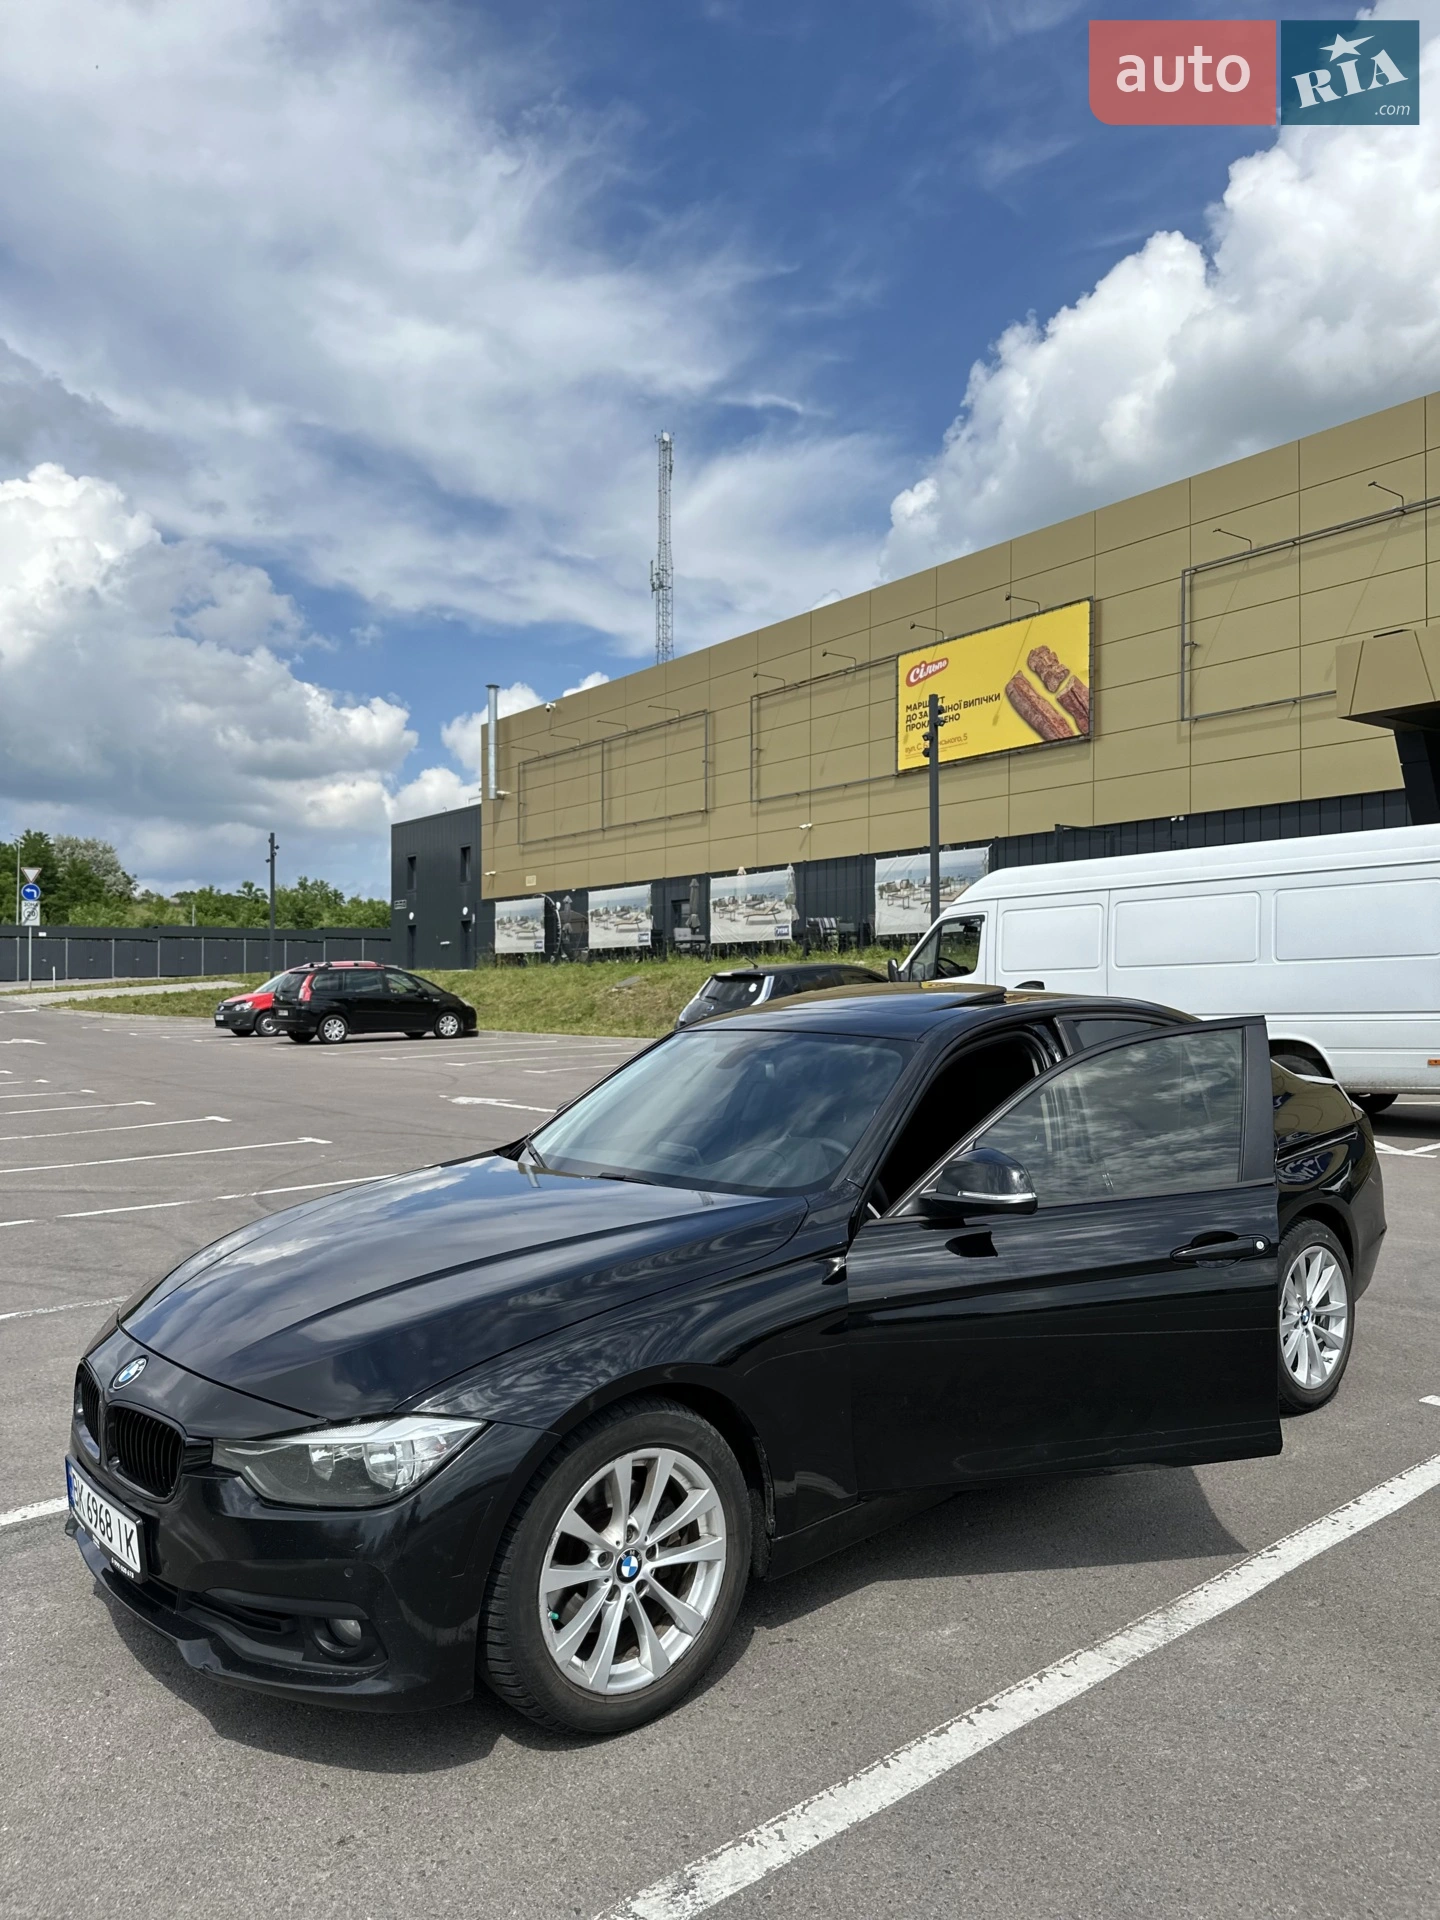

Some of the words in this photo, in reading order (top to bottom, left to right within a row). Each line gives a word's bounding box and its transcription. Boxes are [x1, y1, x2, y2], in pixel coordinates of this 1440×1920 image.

[909, 659, 948, 683] Сільпо
[905, 696, 945, 713] МАРШТ
[905, 713, 917, 724] ДО
[963, 692, 1001, 709] ВИПІЧКИ
[87, 1493, 113, 1543] 6968
[118, 1518, 137, 1565] IK
